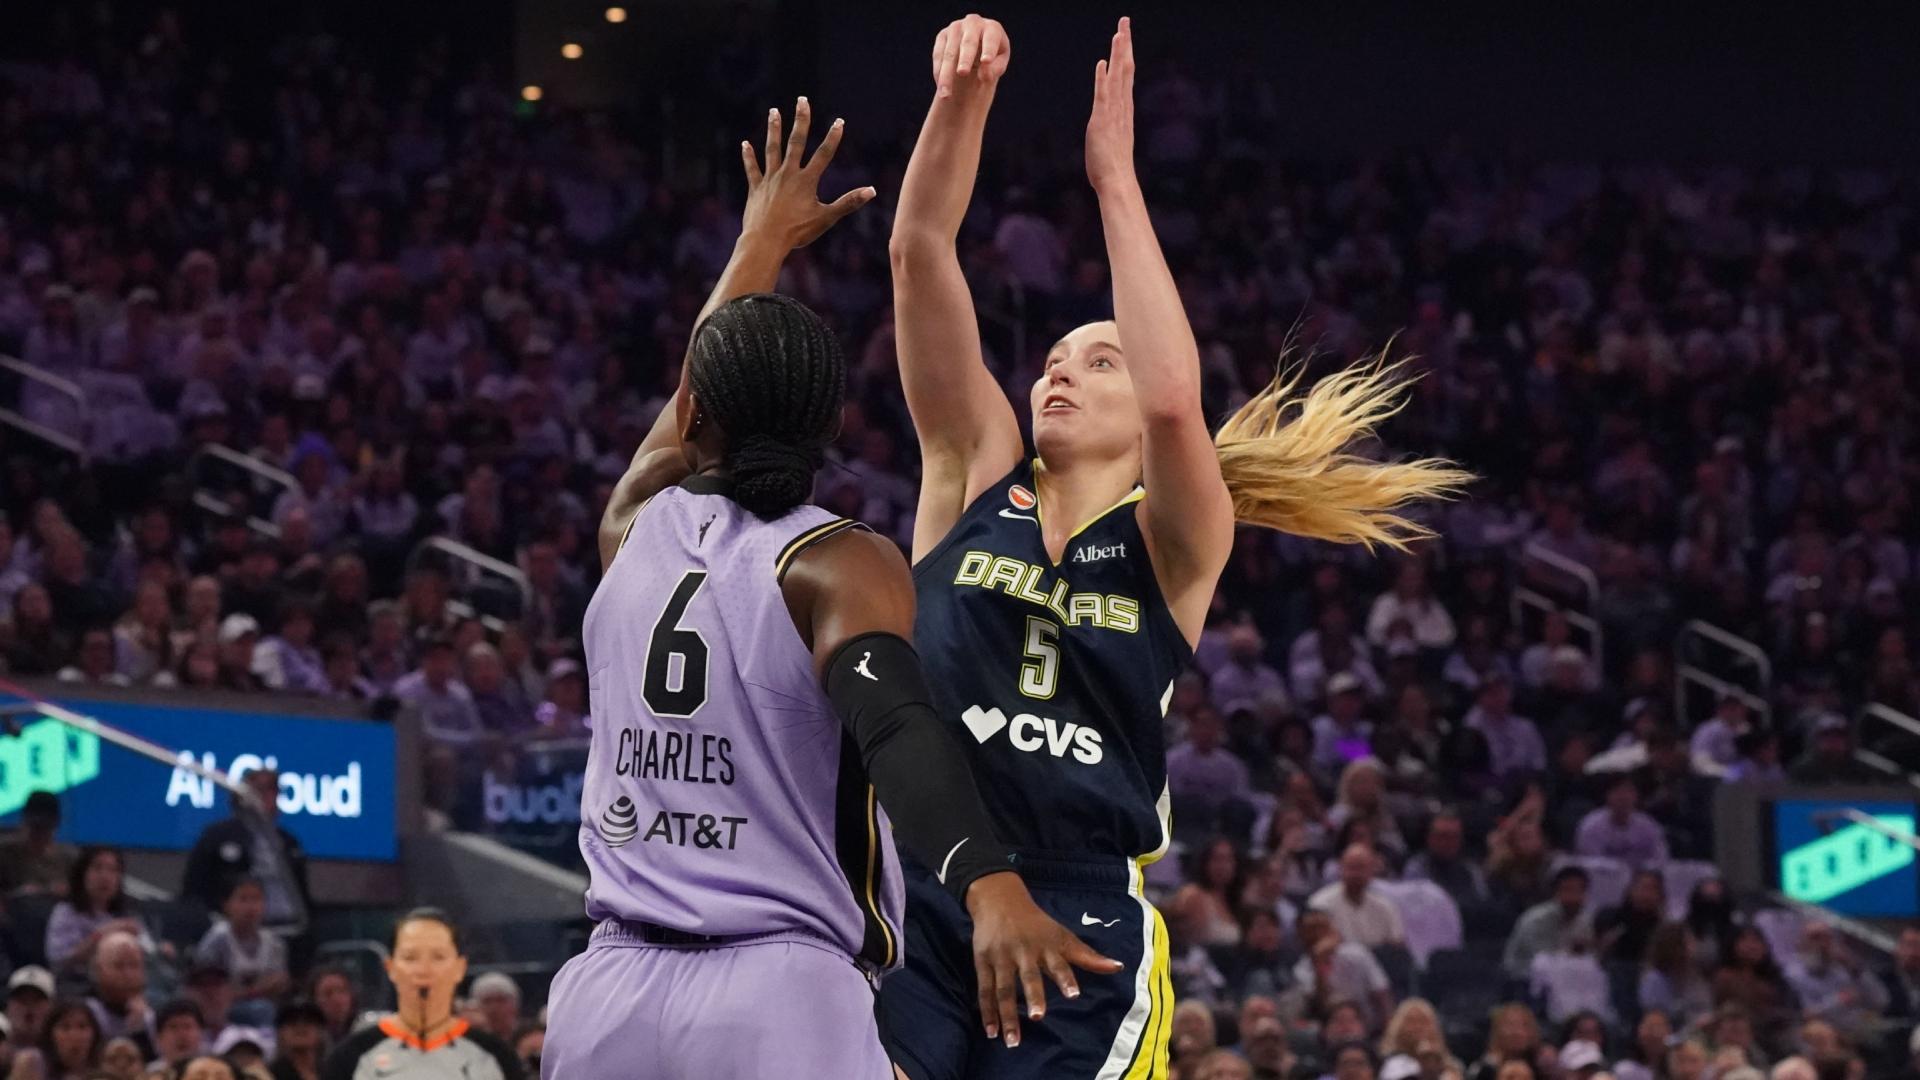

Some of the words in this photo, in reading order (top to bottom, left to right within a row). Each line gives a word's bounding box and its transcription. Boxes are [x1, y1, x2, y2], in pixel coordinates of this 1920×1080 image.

[1072, 543, 1126, 563] Albert
[954, 551, 1139, 634] DALLAS
[641, 569, 710, 719] 6
[1018, 614, 1060, 700] 5
[615, 728, 735, 786] CHARLES
[1008, 713, 1103, 765] CVS
[643, 811, 748, 850] AT&T
